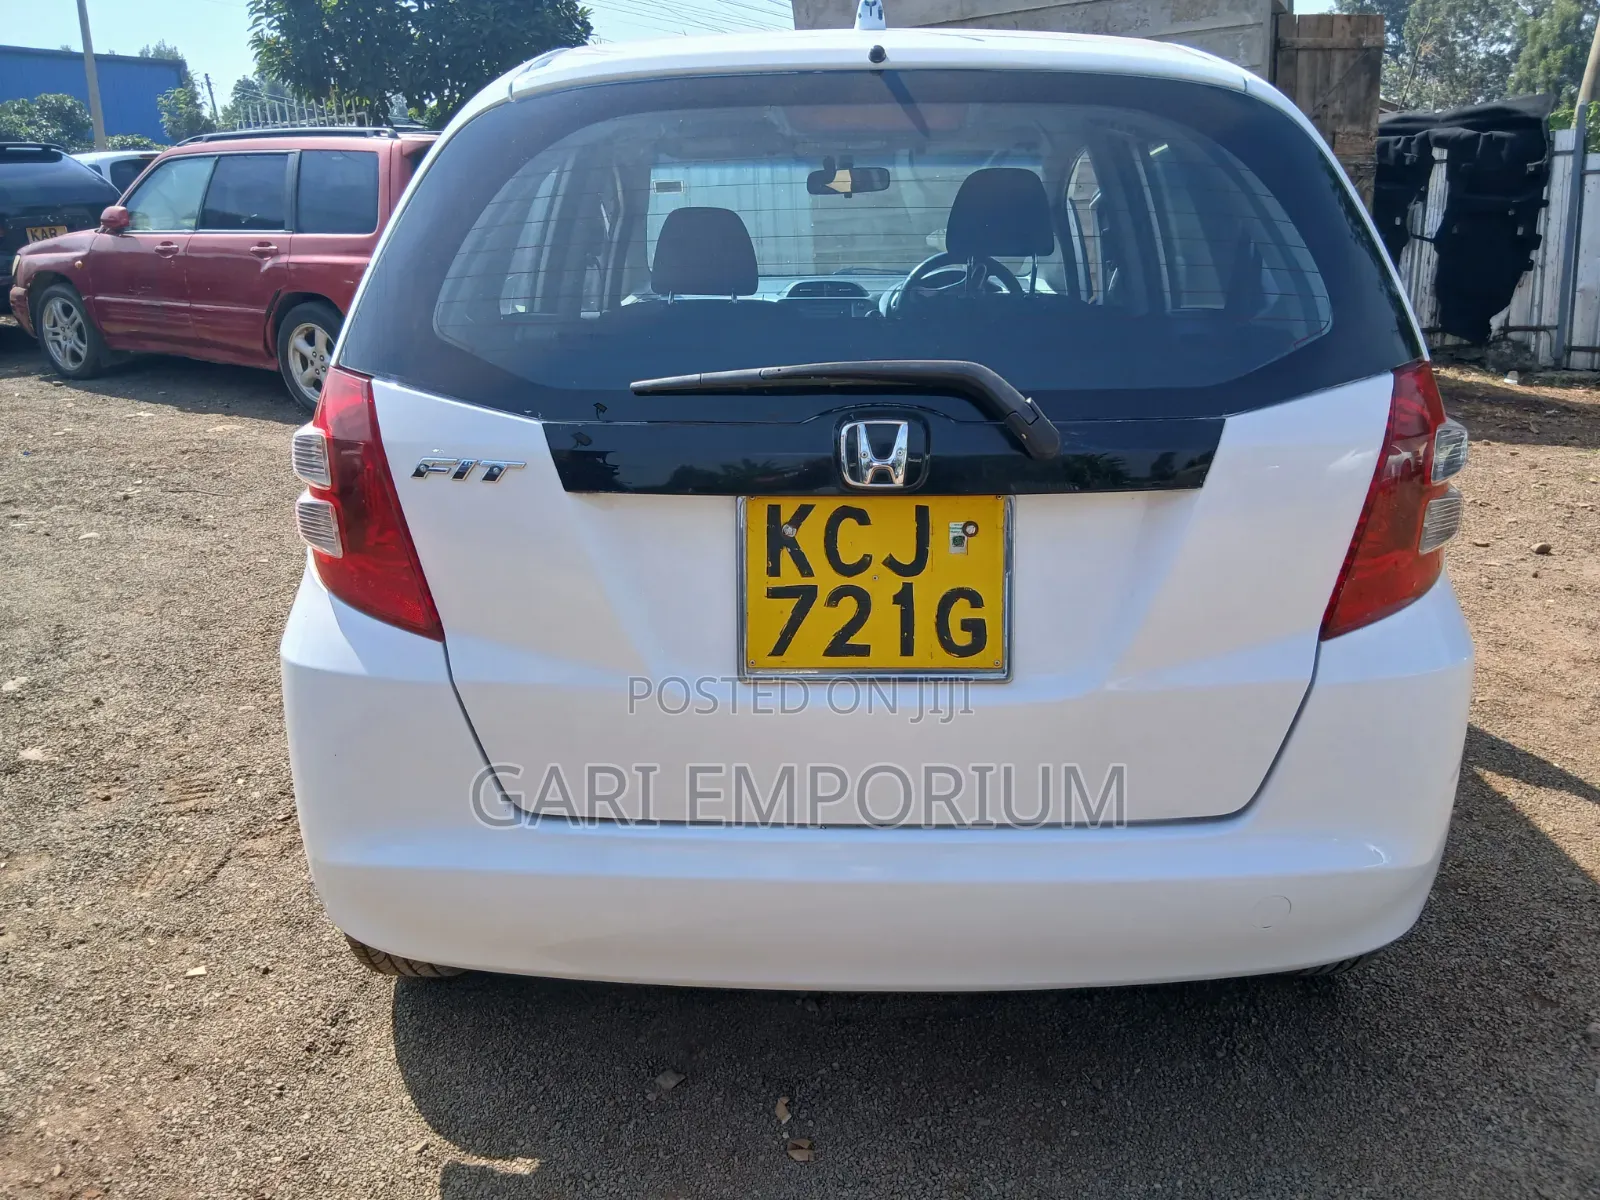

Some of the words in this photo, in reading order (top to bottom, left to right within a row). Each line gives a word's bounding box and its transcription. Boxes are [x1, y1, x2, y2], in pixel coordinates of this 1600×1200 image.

[30, 227, 58, 242] KAR
[410, 457, 527, 482] FIT
[766, 504, 930, 578] KCJ
[765, 582, 988, 658] 721G
